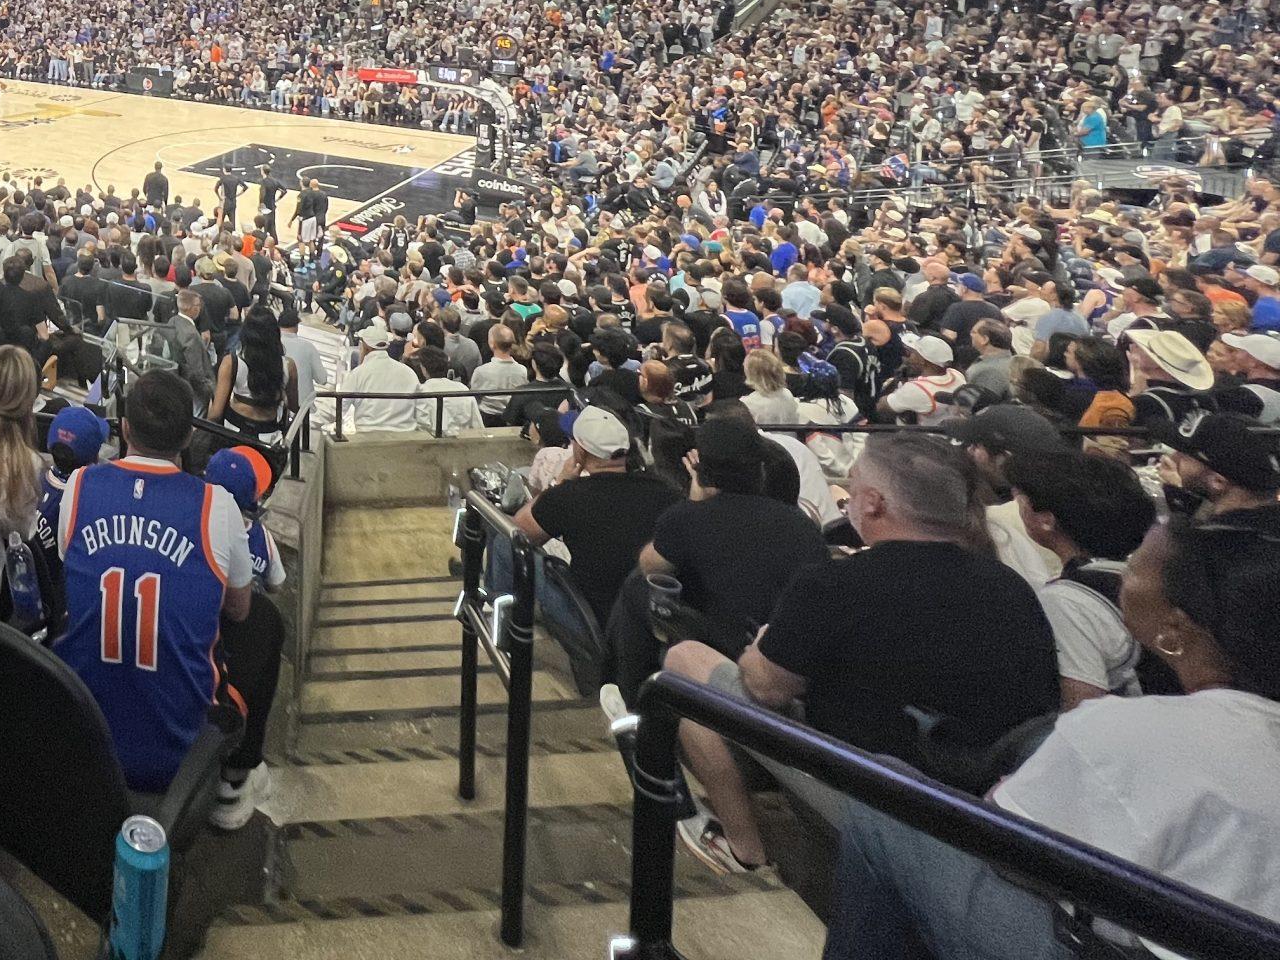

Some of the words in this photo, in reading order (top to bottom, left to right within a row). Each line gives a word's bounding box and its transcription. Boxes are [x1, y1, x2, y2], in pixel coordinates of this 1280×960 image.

[477, 179, 526, 197] coinbas
[81, 514, 195, 568] BRUNSON
[99, 566, 161, 672] 11
